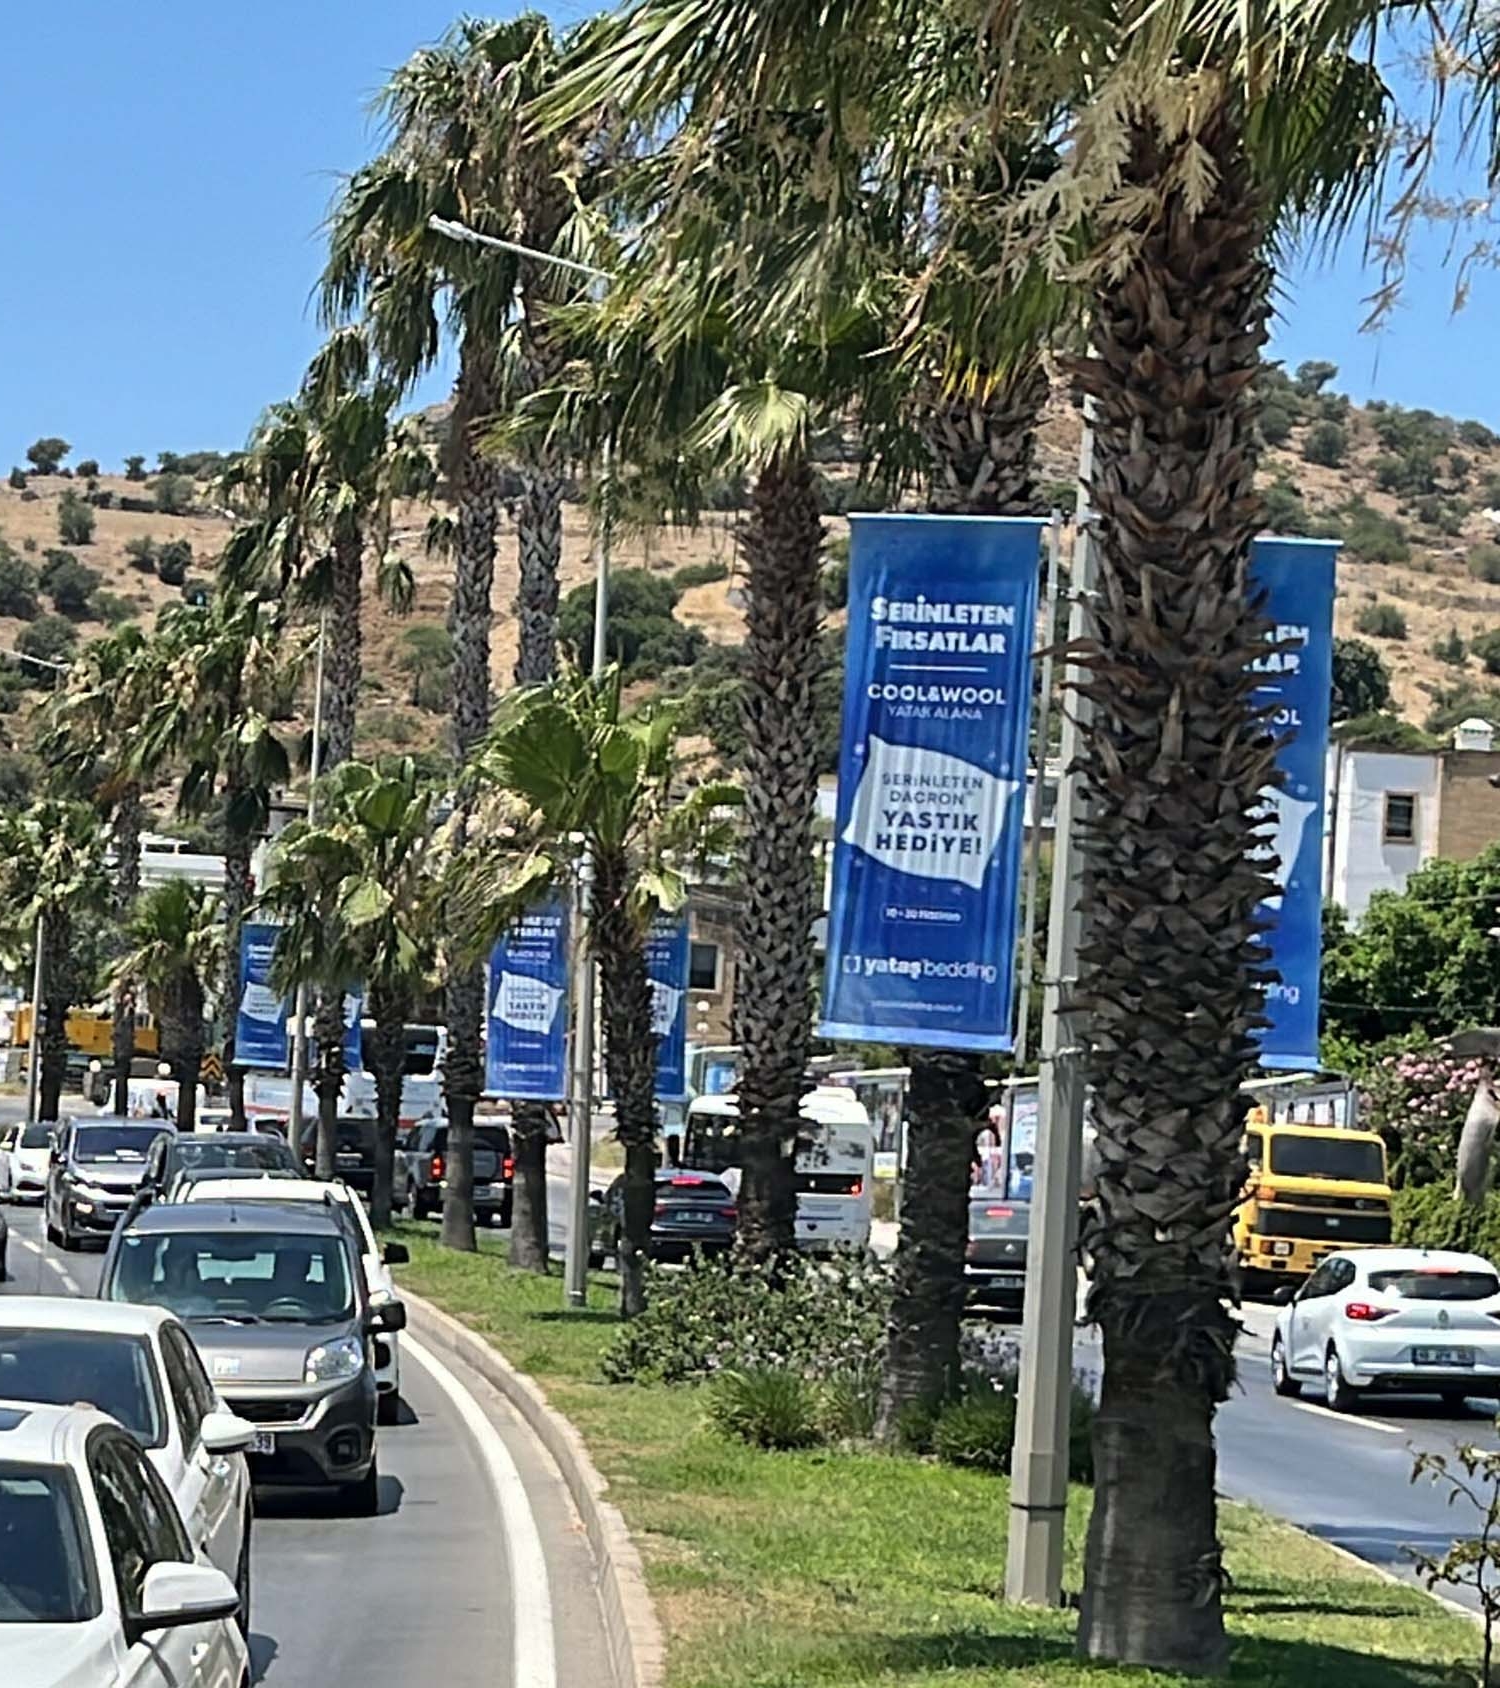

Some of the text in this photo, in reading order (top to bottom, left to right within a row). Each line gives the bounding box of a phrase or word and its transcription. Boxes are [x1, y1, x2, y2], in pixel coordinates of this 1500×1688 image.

[874, 626, 1006, 654] FIRSATLAR
[867, 684, 1007, 705] COOL&WOOL
[887, 705, 931, 718] YATAK
[882, 810, 979, 832] YASTIK
[875, 832, 982, 855] HEDİYE!
